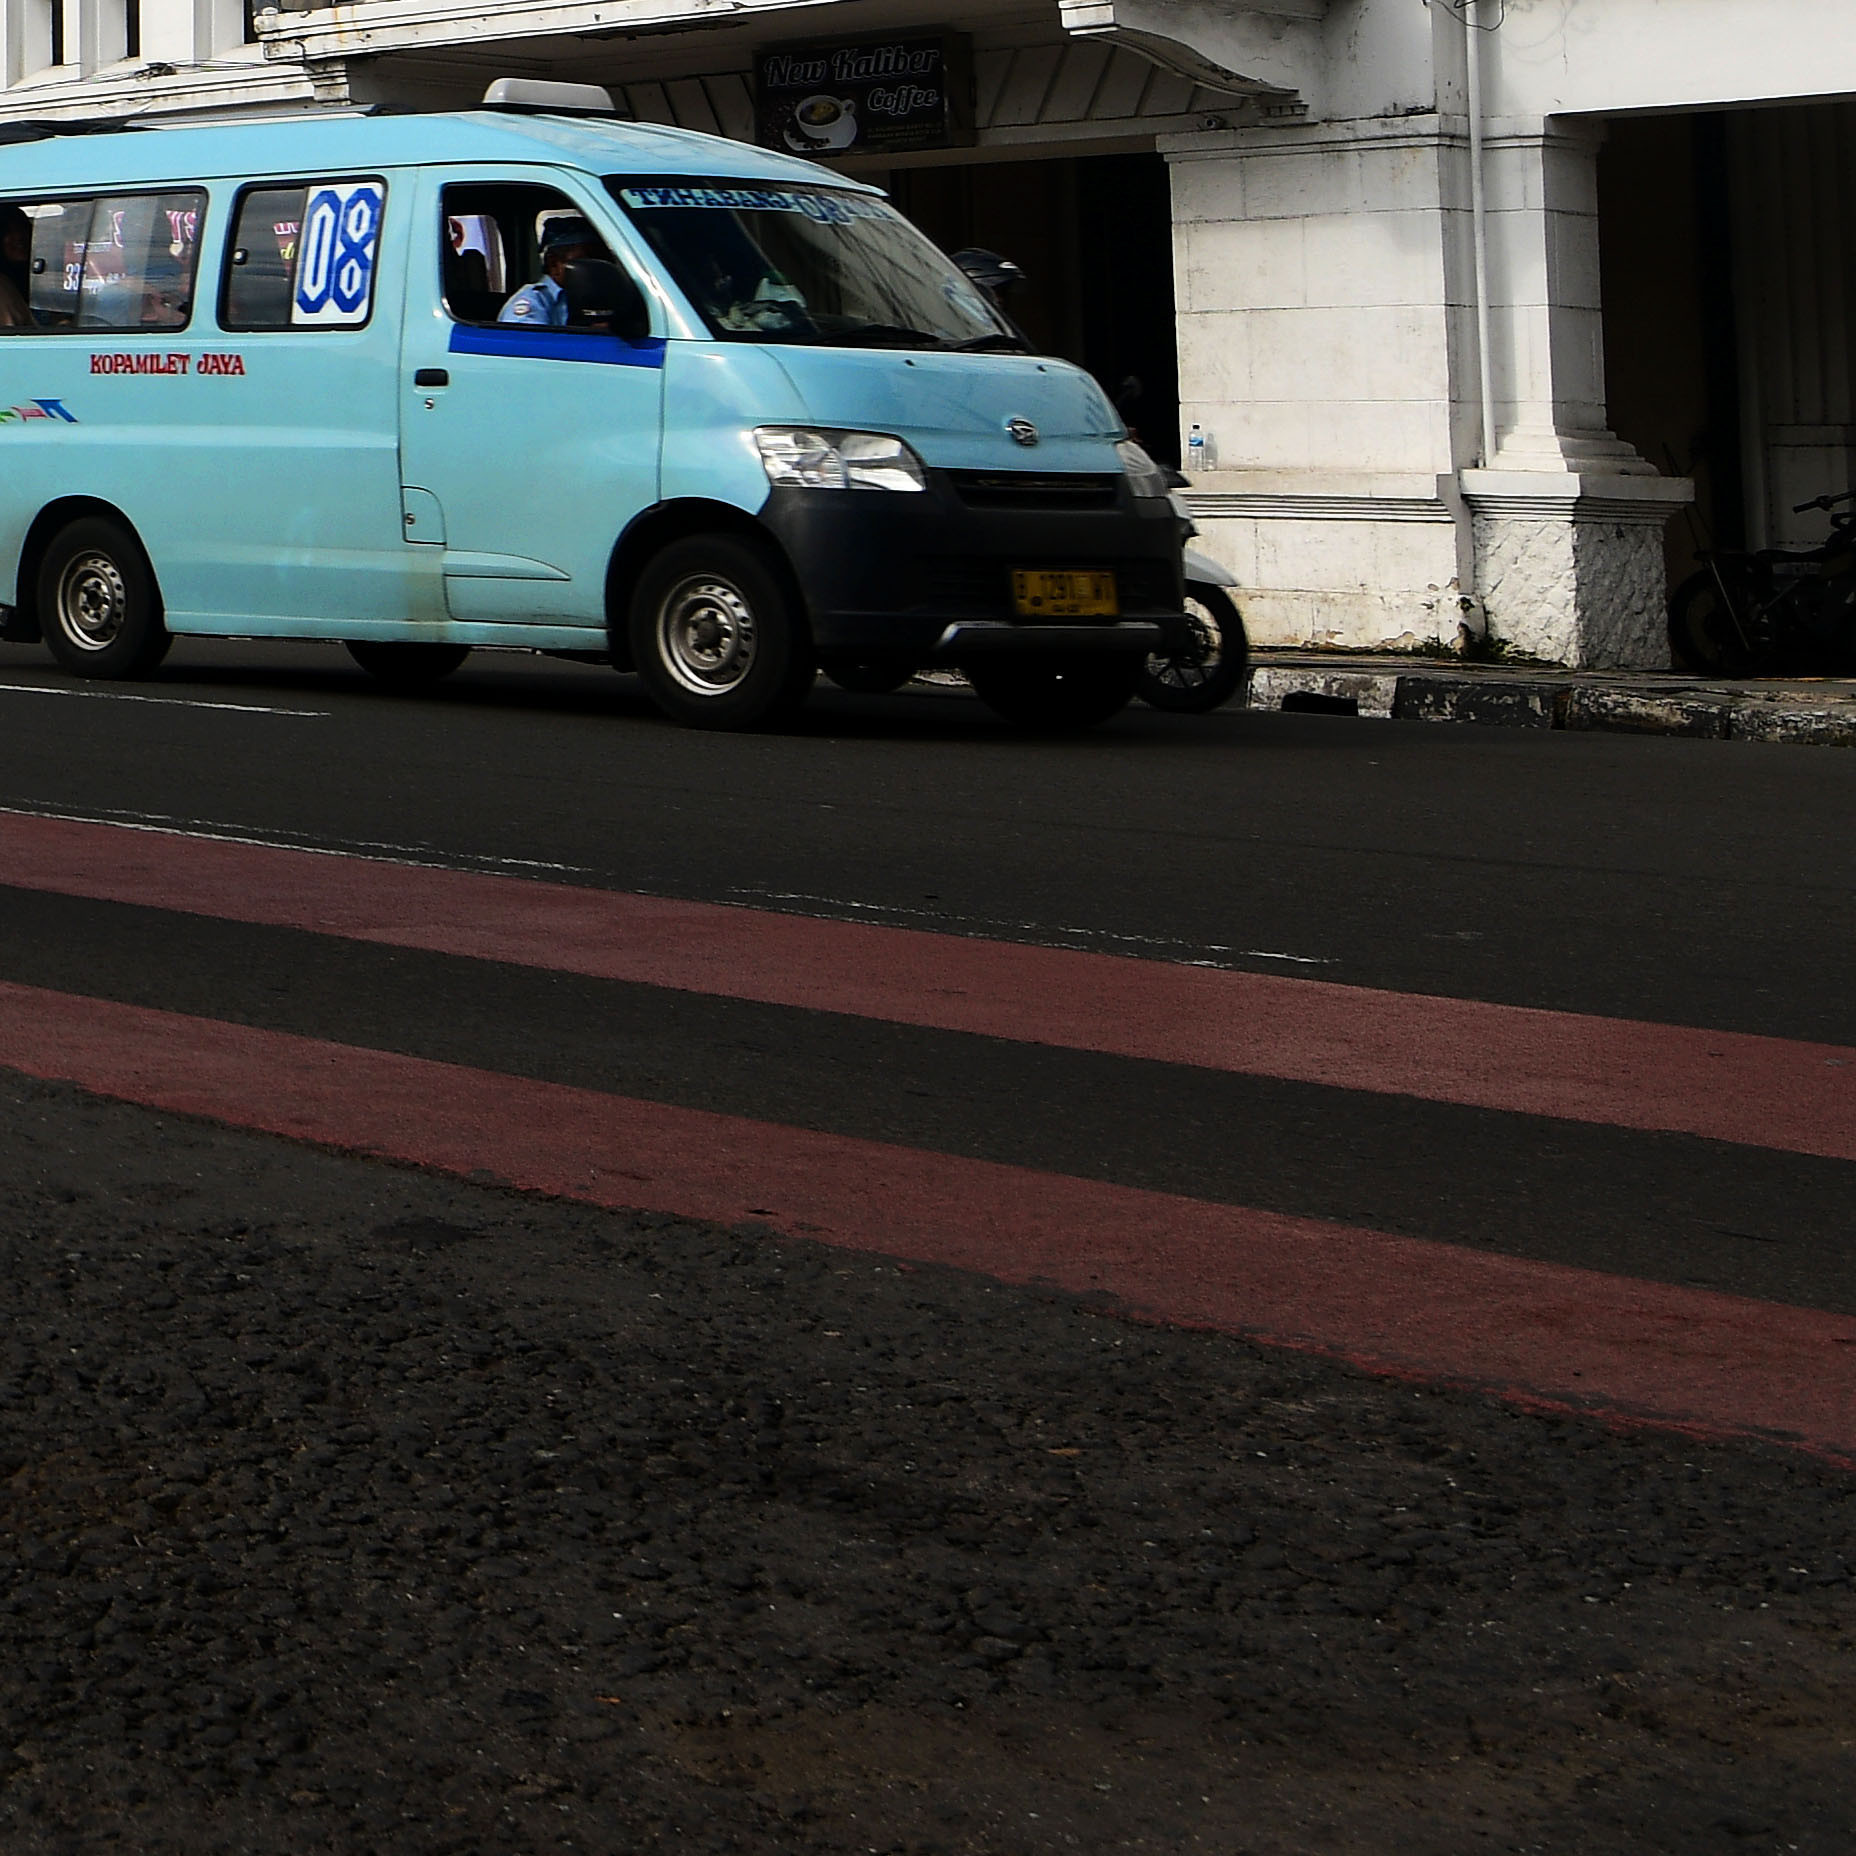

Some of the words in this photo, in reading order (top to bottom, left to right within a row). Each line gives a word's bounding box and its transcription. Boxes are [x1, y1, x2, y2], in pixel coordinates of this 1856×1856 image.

[764, 55, 827, 87] New
[832, 45, 938, 81] Kaliber
[867, 85, 938, 116] Coffee
[296, 187, 383, 314] 08
[89, 353, 192, 375] KOPAMILET
[196, 353, 246, 376] JAYA
